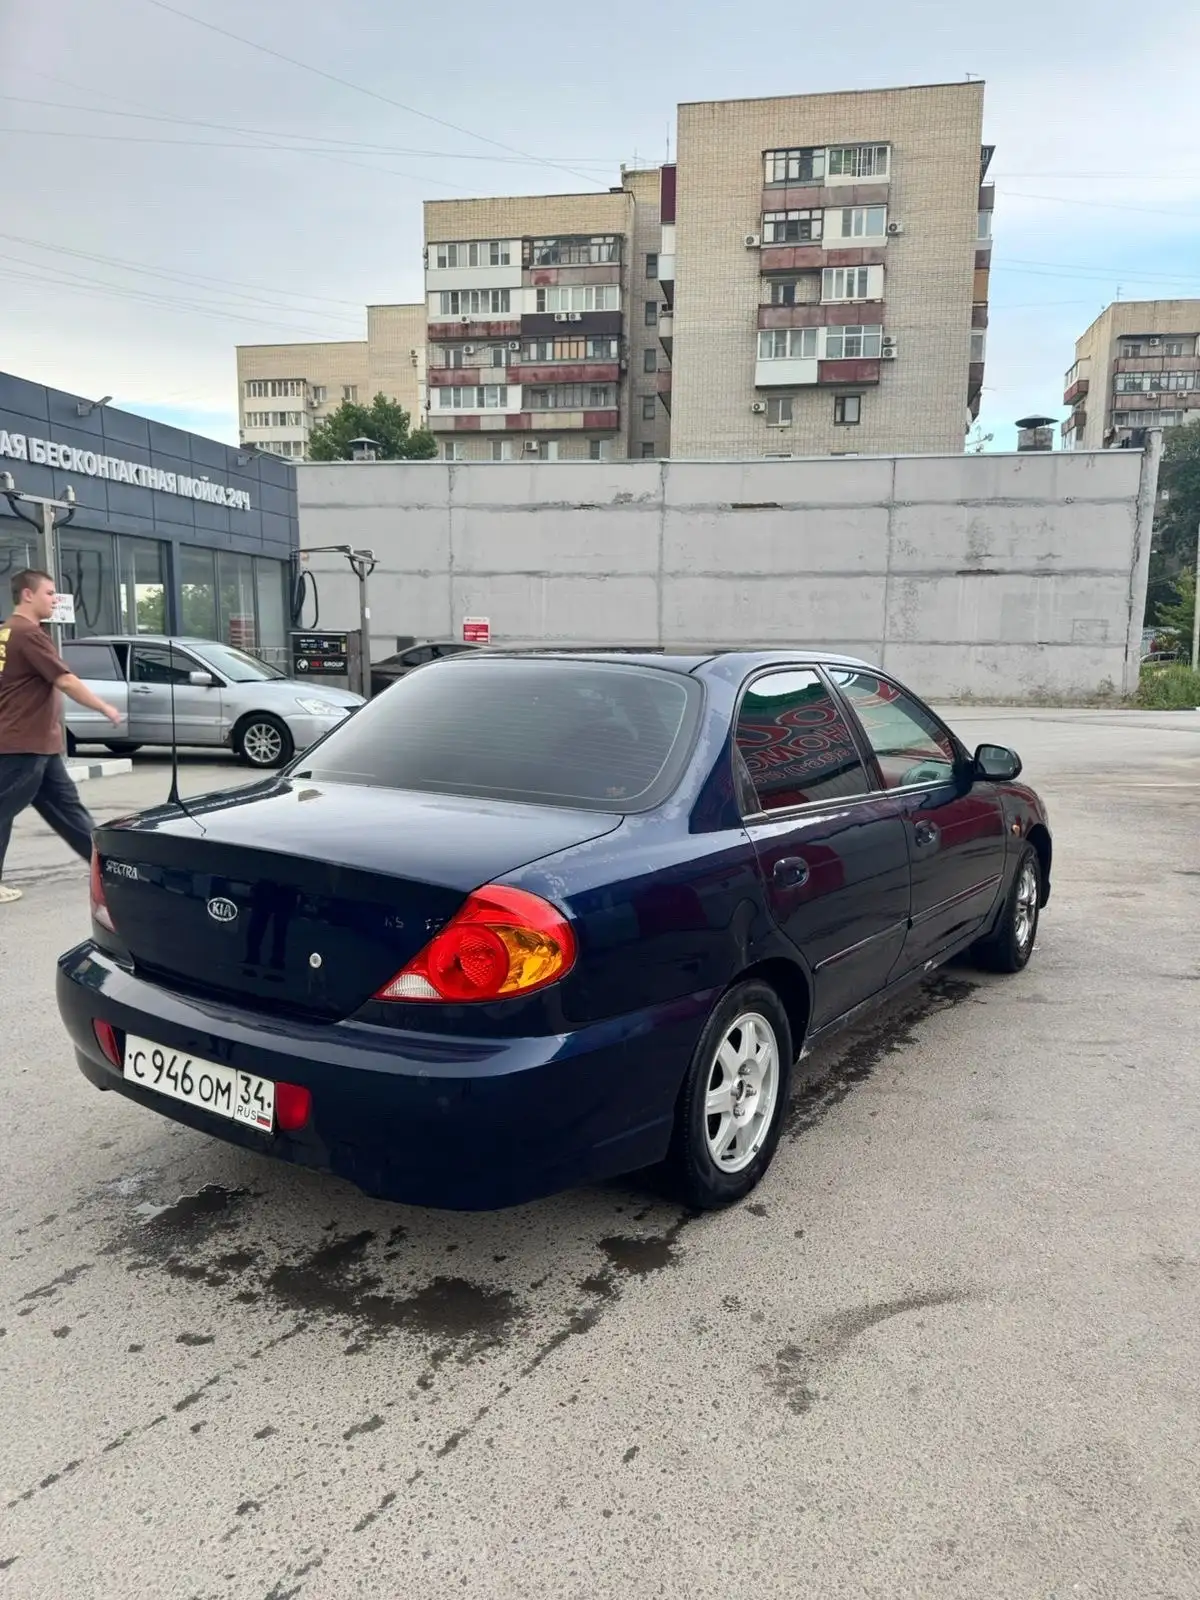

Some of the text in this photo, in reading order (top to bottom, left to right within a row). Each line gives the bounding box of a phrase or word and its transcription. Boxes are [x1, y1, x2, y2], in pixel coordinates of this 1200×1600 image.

[28, 437, 177, 494] БЕСКОНТАКТНАЯ
[177, 475, 226, 505] МОЙКА
[105, 860, 139, 881] SPECTRA
[211, 901, 232, 918] KIA
[240, 1075, 265, 1111] 34
[237, 1104, 257, 1121] RUS
